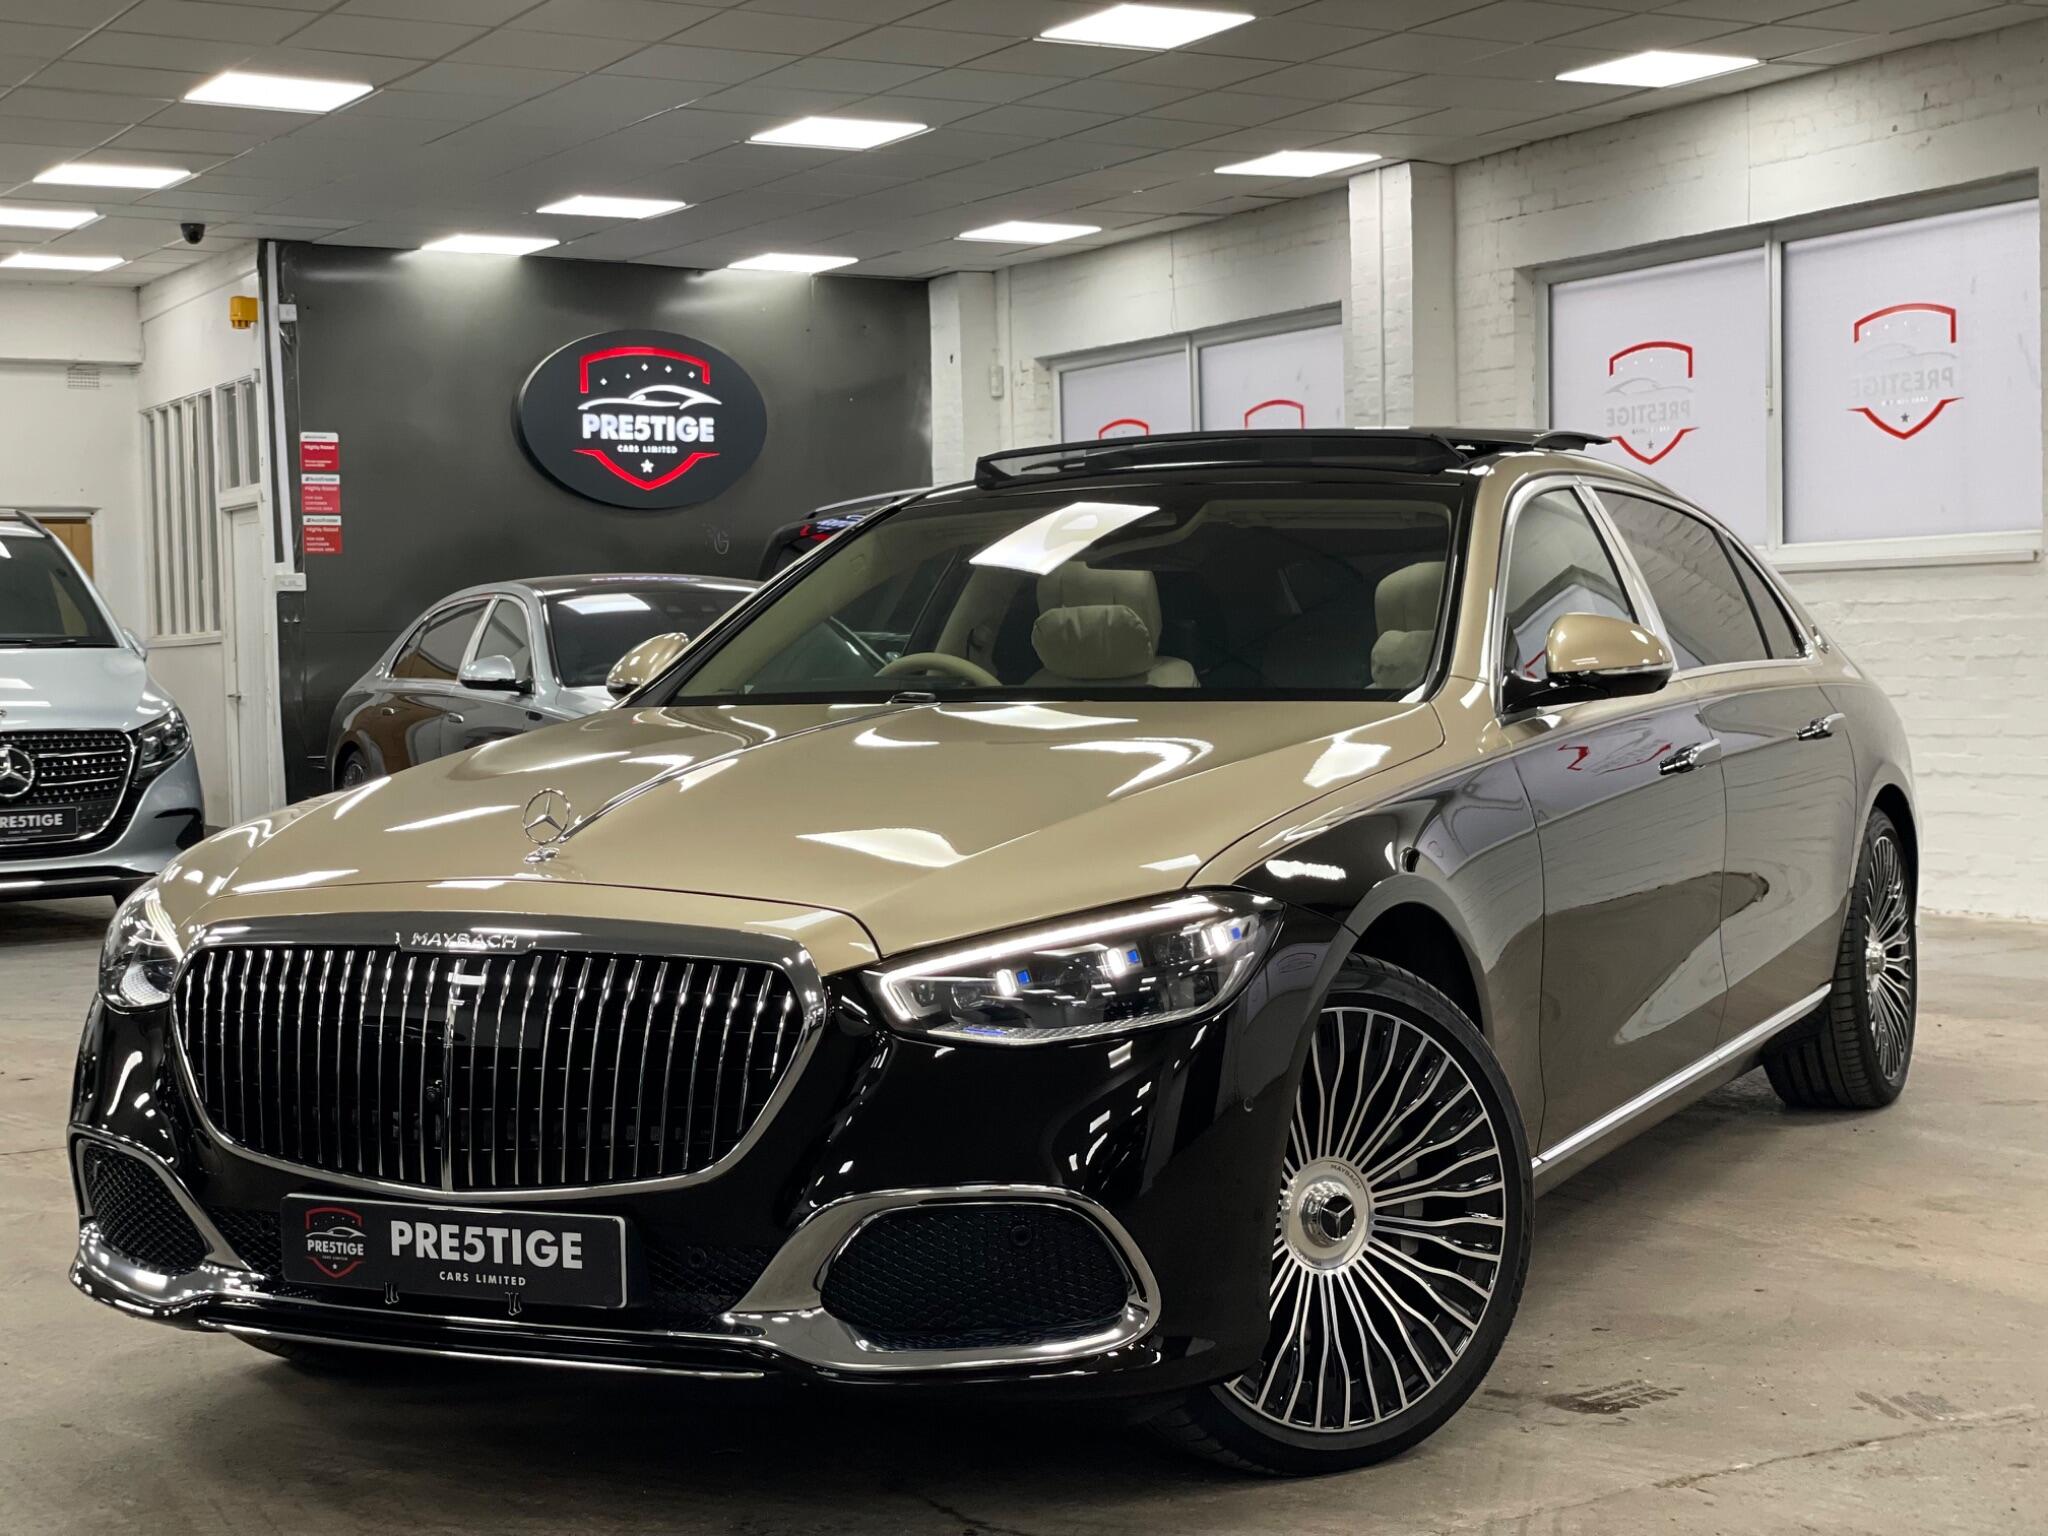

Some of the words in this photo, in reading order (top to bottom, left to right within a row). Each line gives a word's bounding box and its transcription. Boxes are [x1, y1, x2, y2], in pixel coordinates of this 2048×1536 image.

[582, 413, 715, 442] PRE5TIGE
[616, 444, 640, 453] CARS
[642, 445, 678, 454] LIMITED
[411, 932, 518, 949] MAYBACH
[1331, 1164, 1361, 1189] MAYBACH
[391, 1220, 583, 1270] PRE5TIGE
[439, 1271, 469, 1282] CARS
[476, 1273, 526, 1286] LIMITED
